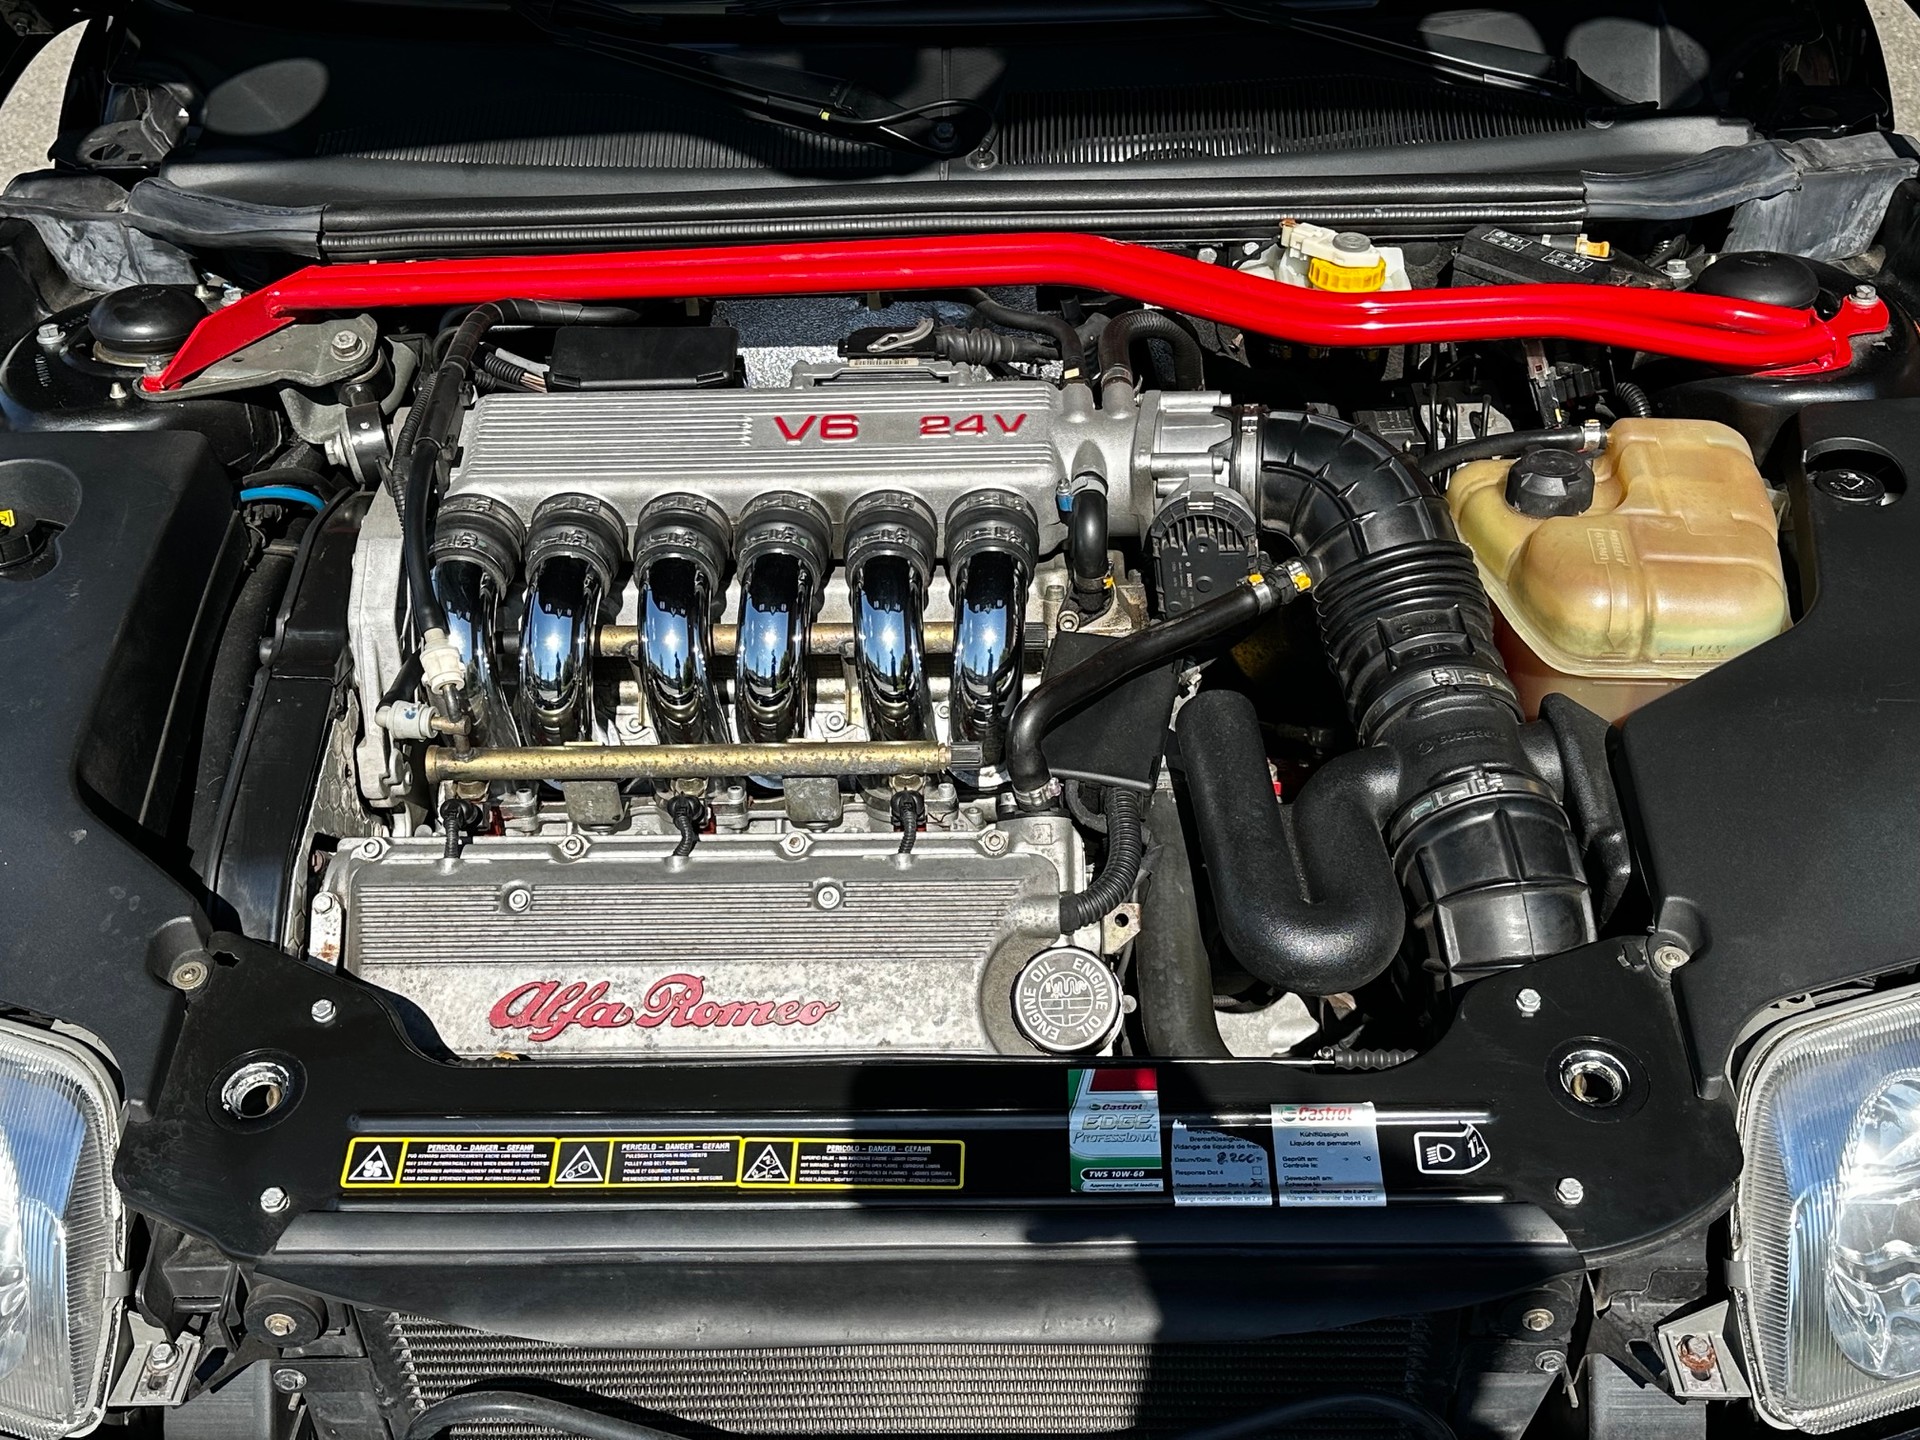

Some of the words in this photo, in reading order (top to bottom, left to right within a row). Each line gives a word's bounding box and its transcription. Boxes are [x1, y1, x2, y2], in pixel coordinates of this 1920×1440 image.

[774, 415, 859, 441] V6
[920, 414, 1027, 434] 24V
[1030, 961, 1056, 982] OIL
[1072, 957, 1108, 1010] ENGINE
[489, 980, 634, 1042] Alfa
[635, 973, 841, 1028] Romeo
[1023, 987, 1060, 1041] ENGINE
[1071, 1015, 1102, 1037] OIL
[1102, 1103, 1143, 1111] Castrol
[1299, 1106, 1352, 1121] Castrol
[1082, 1113, 1155, 1130] EDGE
